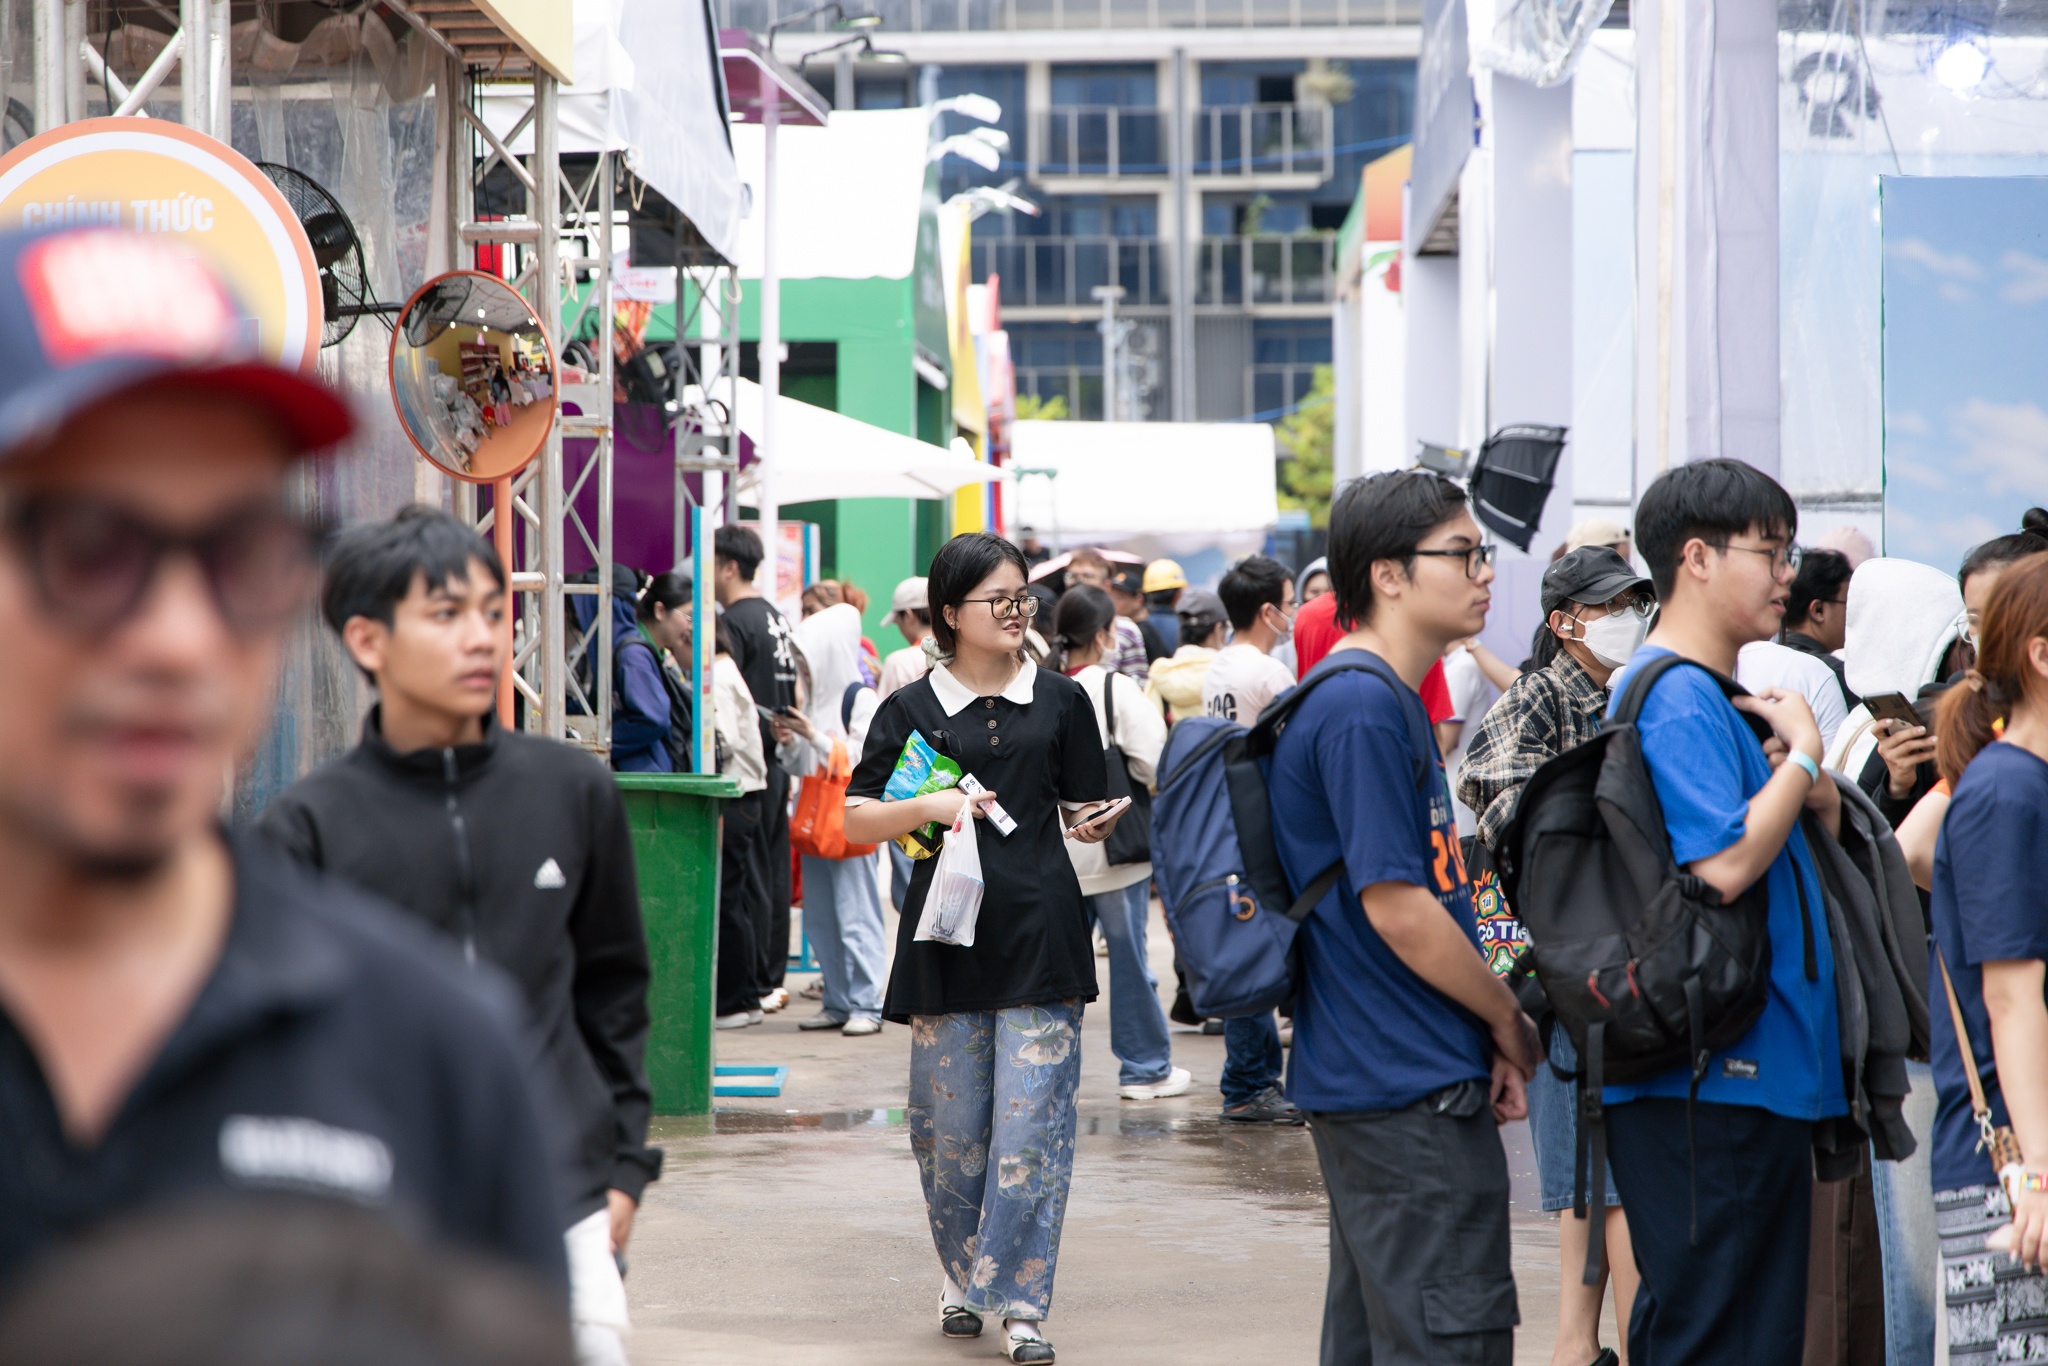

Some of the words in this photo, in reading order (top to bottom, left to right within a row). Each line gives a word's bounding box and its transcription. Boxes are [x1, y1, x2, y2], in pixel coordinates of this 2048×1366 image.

[22, 194, 121, 232] CHÍNH
[130, 191, 214, 233] THỨC
[1478, 920, 1495, 942] Có
